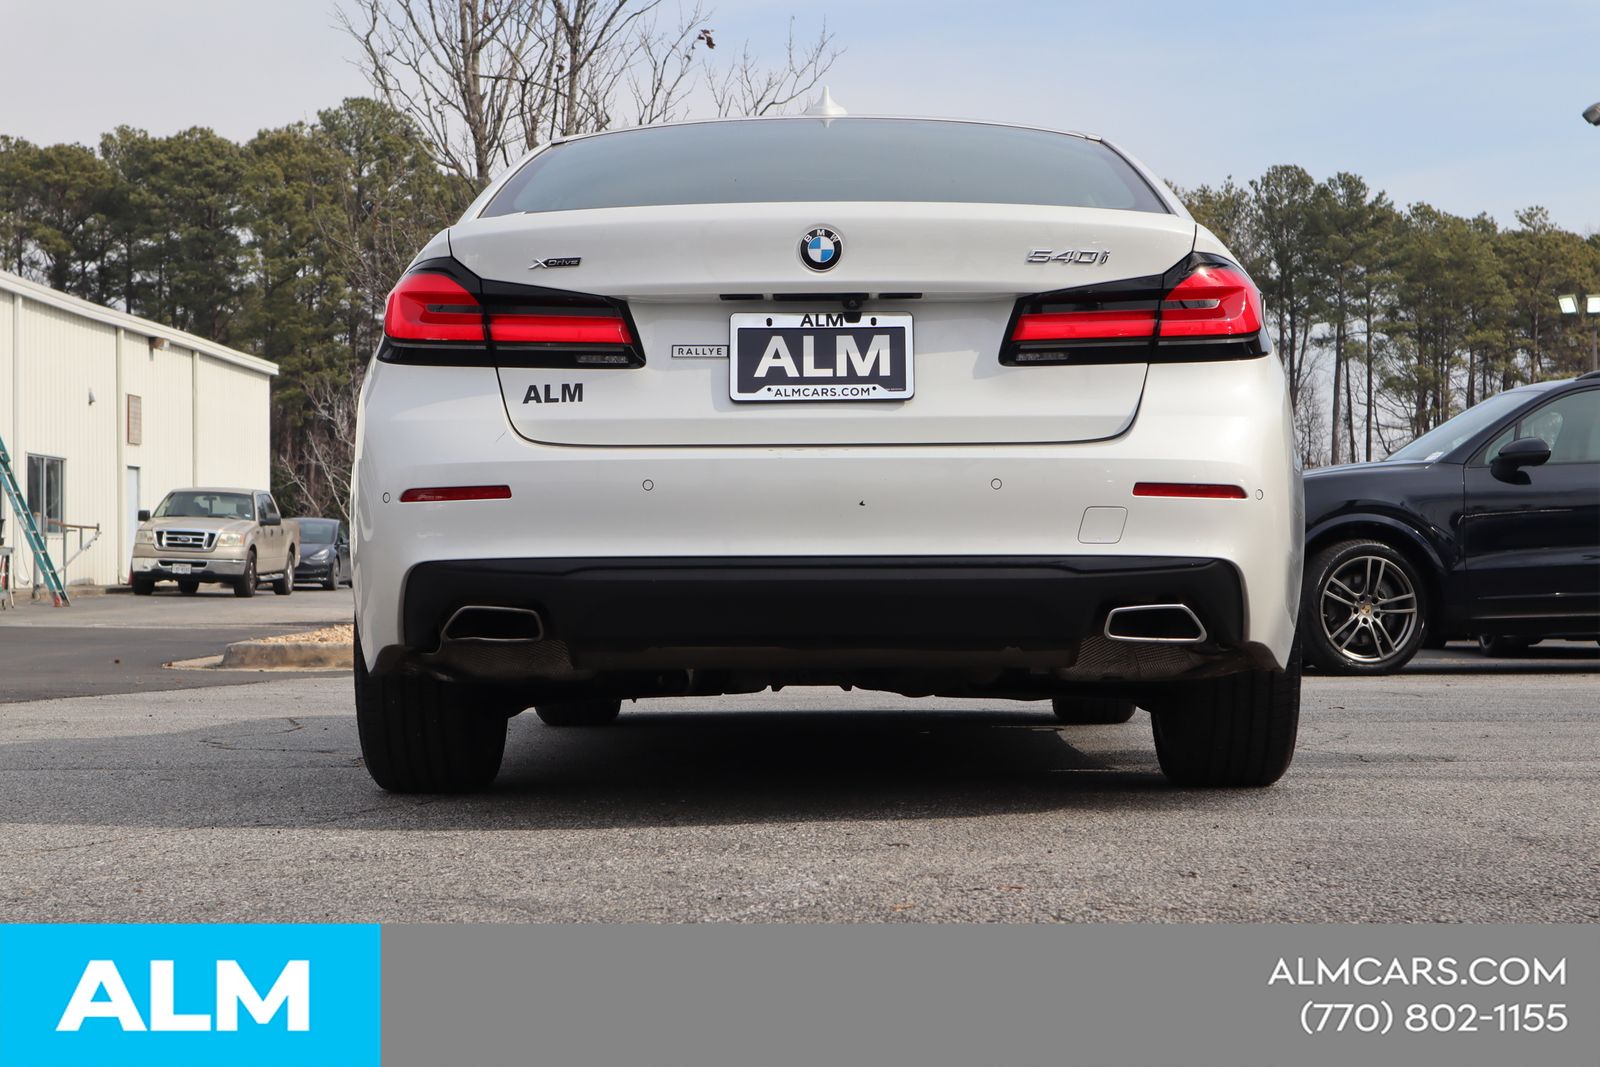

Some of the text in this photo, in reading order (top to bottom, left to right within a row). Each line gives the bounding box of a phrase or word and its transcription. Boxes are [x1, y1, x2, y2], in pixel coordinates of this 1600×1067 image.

[803, 229, 840, 243] BMW
[1026, 249, 1111, 264] 540i
[800, 313, 844, 327] ALM
[677, 347, 722, 356] RALLYE
[753, 334, 891, 378] ALM
[522, 383, 584, 404] ALM
[774, 387, 870, 398] ALMCARS.COM
